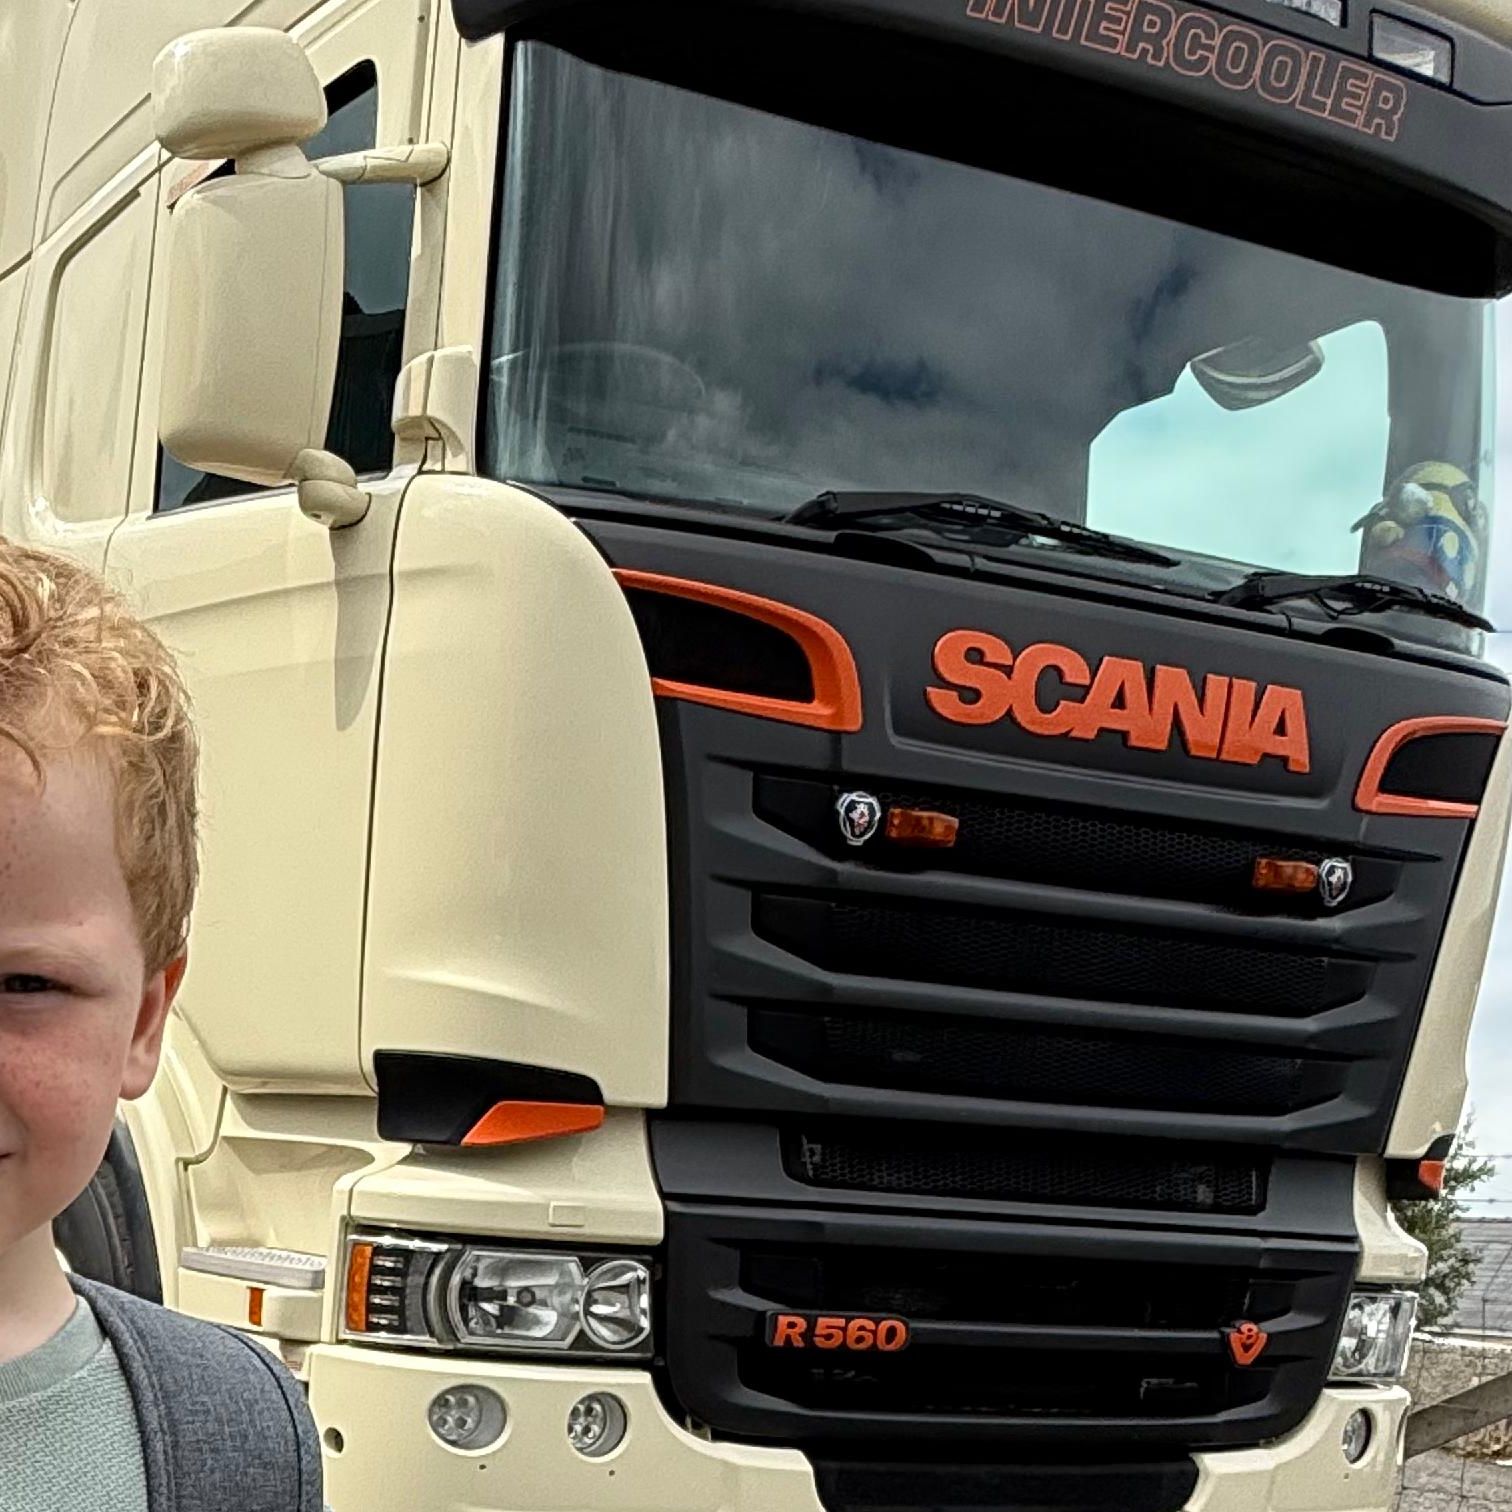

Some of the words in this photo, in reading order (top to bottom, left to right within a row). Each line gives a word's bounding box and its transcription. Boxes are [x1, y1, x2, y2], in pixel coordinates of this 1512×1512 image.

[926, 629, 1310, 774] SCANIA
[773, 1314, 808, 1348] R
[813, 1317, 906, 1351] 560
